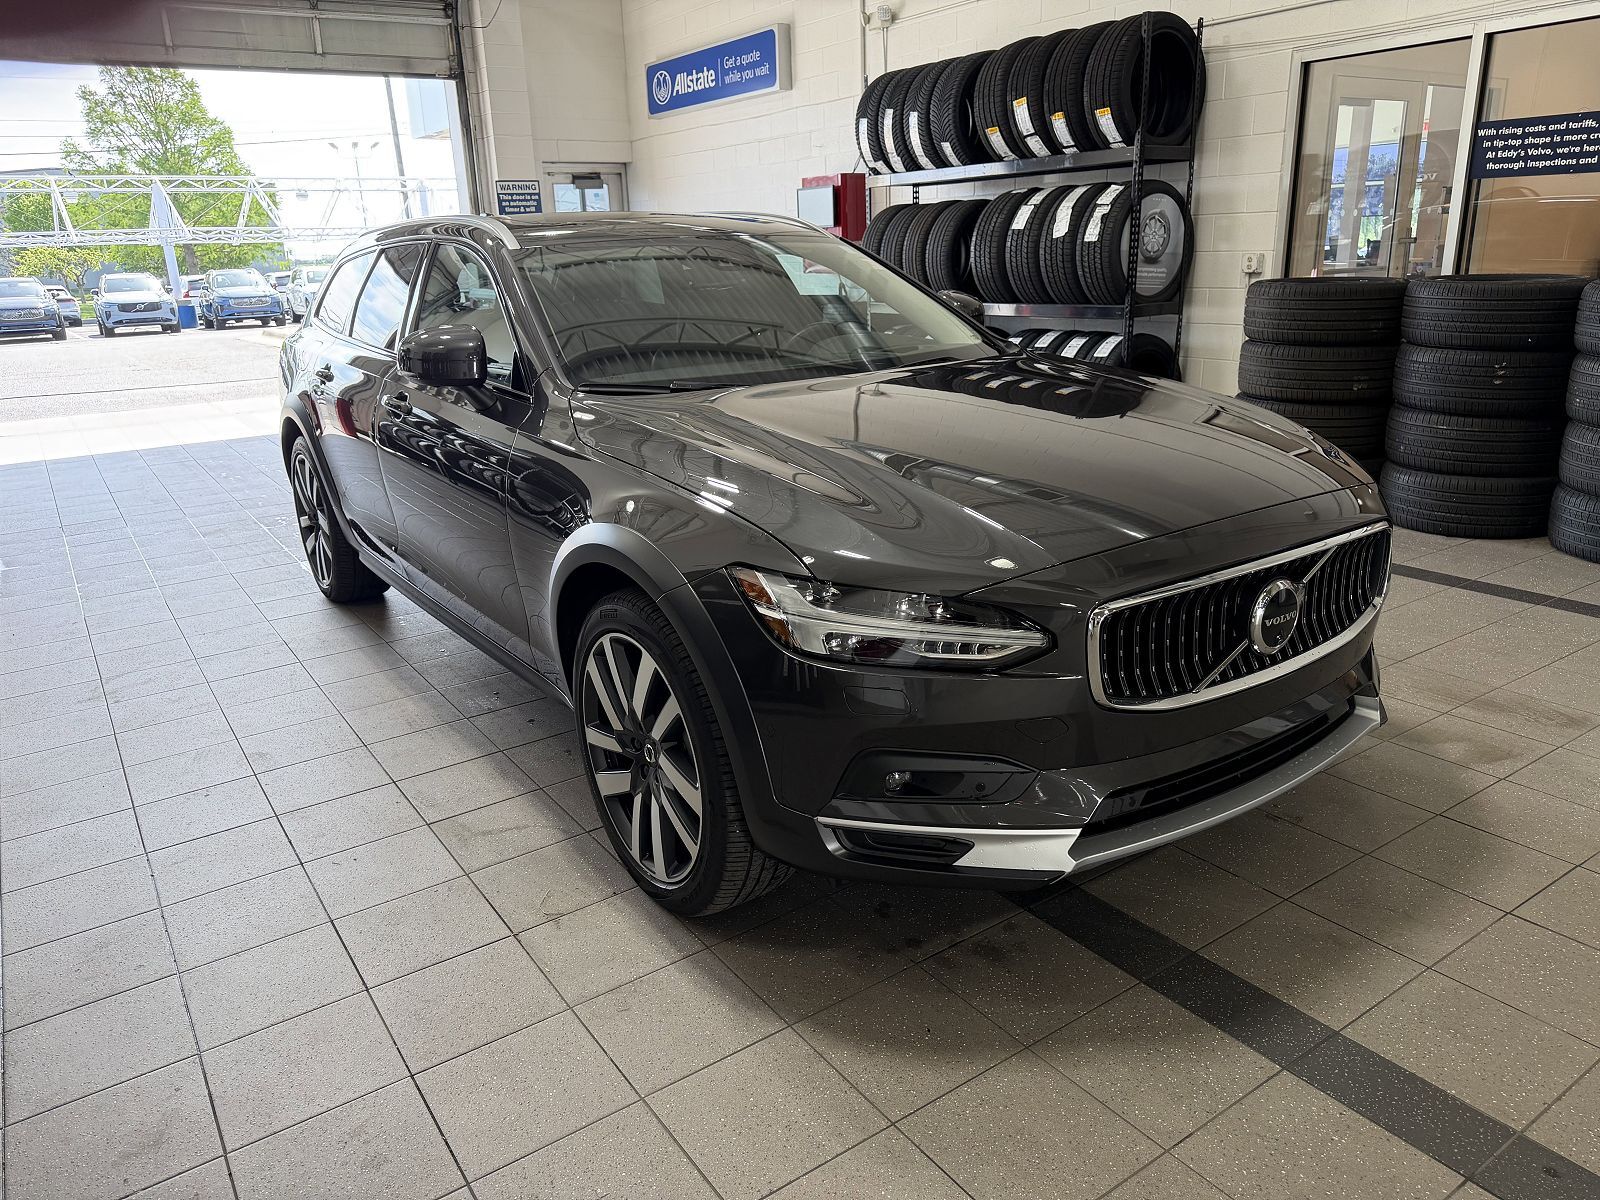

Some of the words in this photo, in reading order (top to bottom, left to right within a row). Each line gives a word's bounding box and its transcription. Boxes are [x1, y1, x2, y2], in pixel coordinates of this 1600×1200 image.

[723, 56, 735, 69] Get
[735, 55, 741, 66] a
[741, 50, 761, 66] quote
[673, 67, 715, 96] Allstate
[724, 70, 741, 85] while
[741, 70, 754, 83] you
[754, 62, 770, 77] wait
[1477, 128, 1496, 137] With
[1498, 126, 1523, 135] rising
[1525, 124, 1547, 133] costs
[1548, 121, 1567, 131] and
[1569, 119, 1599, 129] tariffs,
[1482, 140, 1491, 148] in
[1493, 137, 1522, 148] tip-top
[1524, 136, 1551, 145] shape
[1553, 134, 1561, 142] is
[1563, 133, 1588, 142] more
[1485, 151, 1495, 159] At
[1527, 147, 1554, 156] Volvo,
[1556, 145, 1580, 154] we're
[1486, 160, 1525, 170] thorough
[1527, 157, 1577, 168] inspections
[1579, 155, 1598, 165] and
[498, 183, 537, 191] WARNING
[1264, 610, 1296, 626] VOLVO
